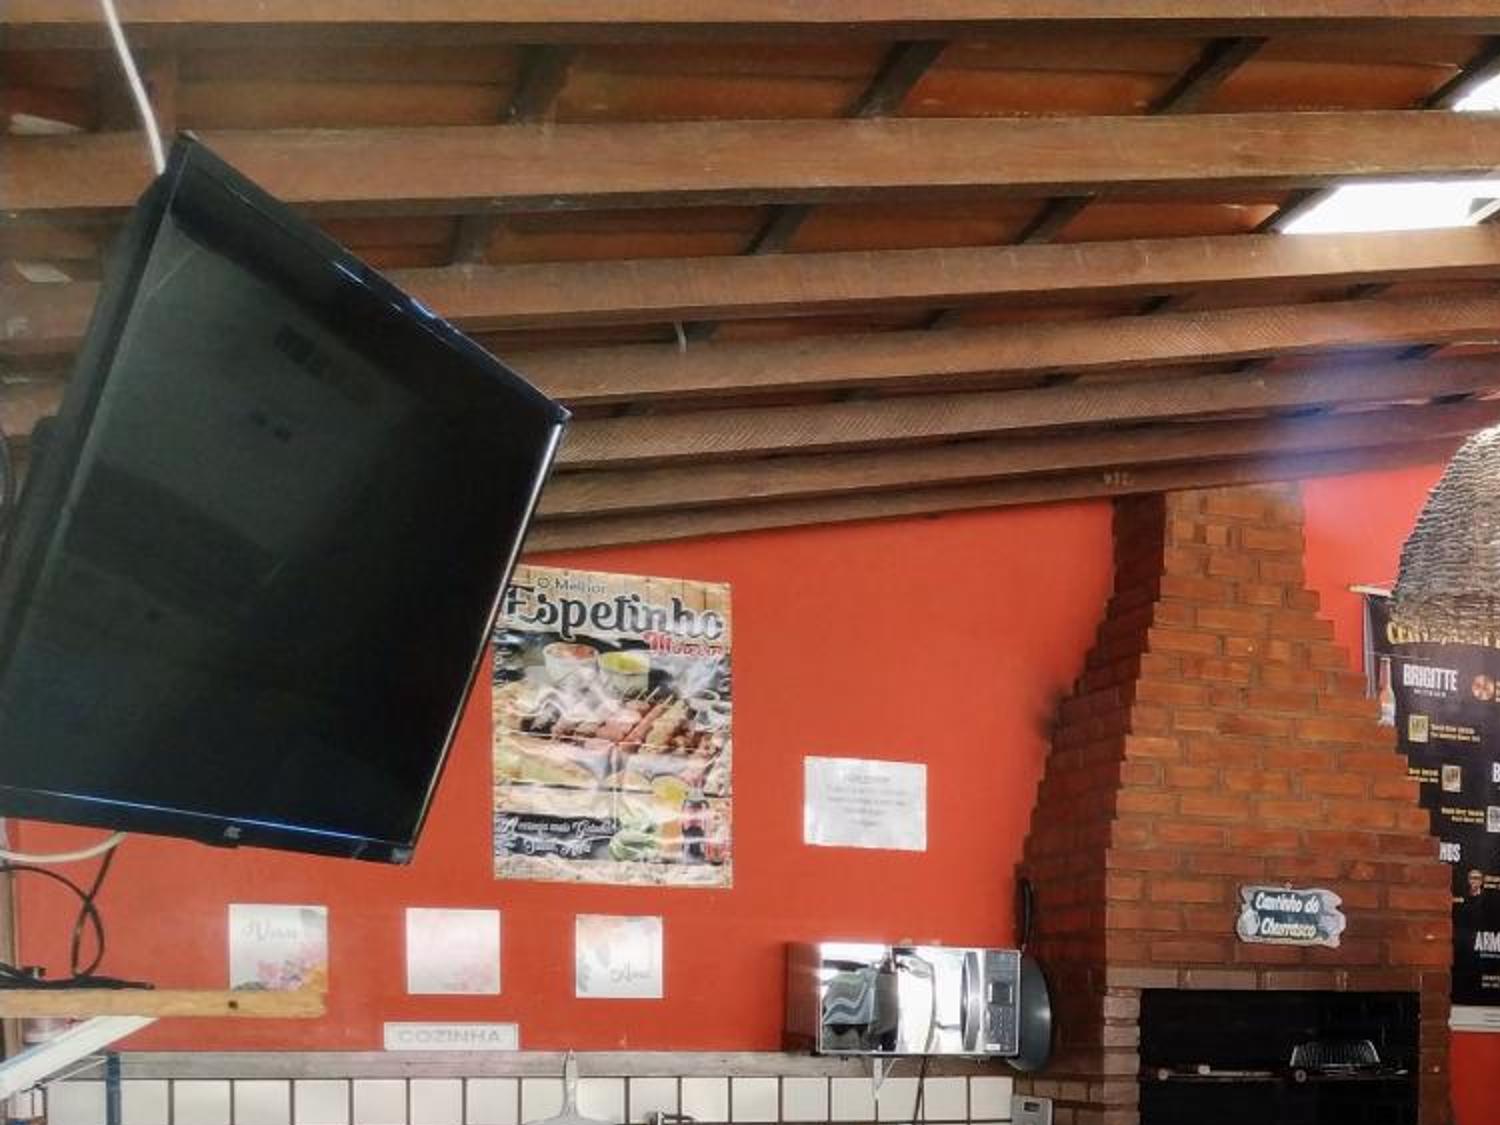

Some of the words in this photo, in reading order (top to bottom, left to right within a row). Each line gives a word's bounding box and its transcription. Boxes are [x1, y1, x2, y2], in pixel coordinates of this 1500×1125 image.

[506, 583, 724, 642] Espetinho
[1403, 663, 1458, 692] BRIGITTE
[398, 1028, 501, 1043] COZINHA
